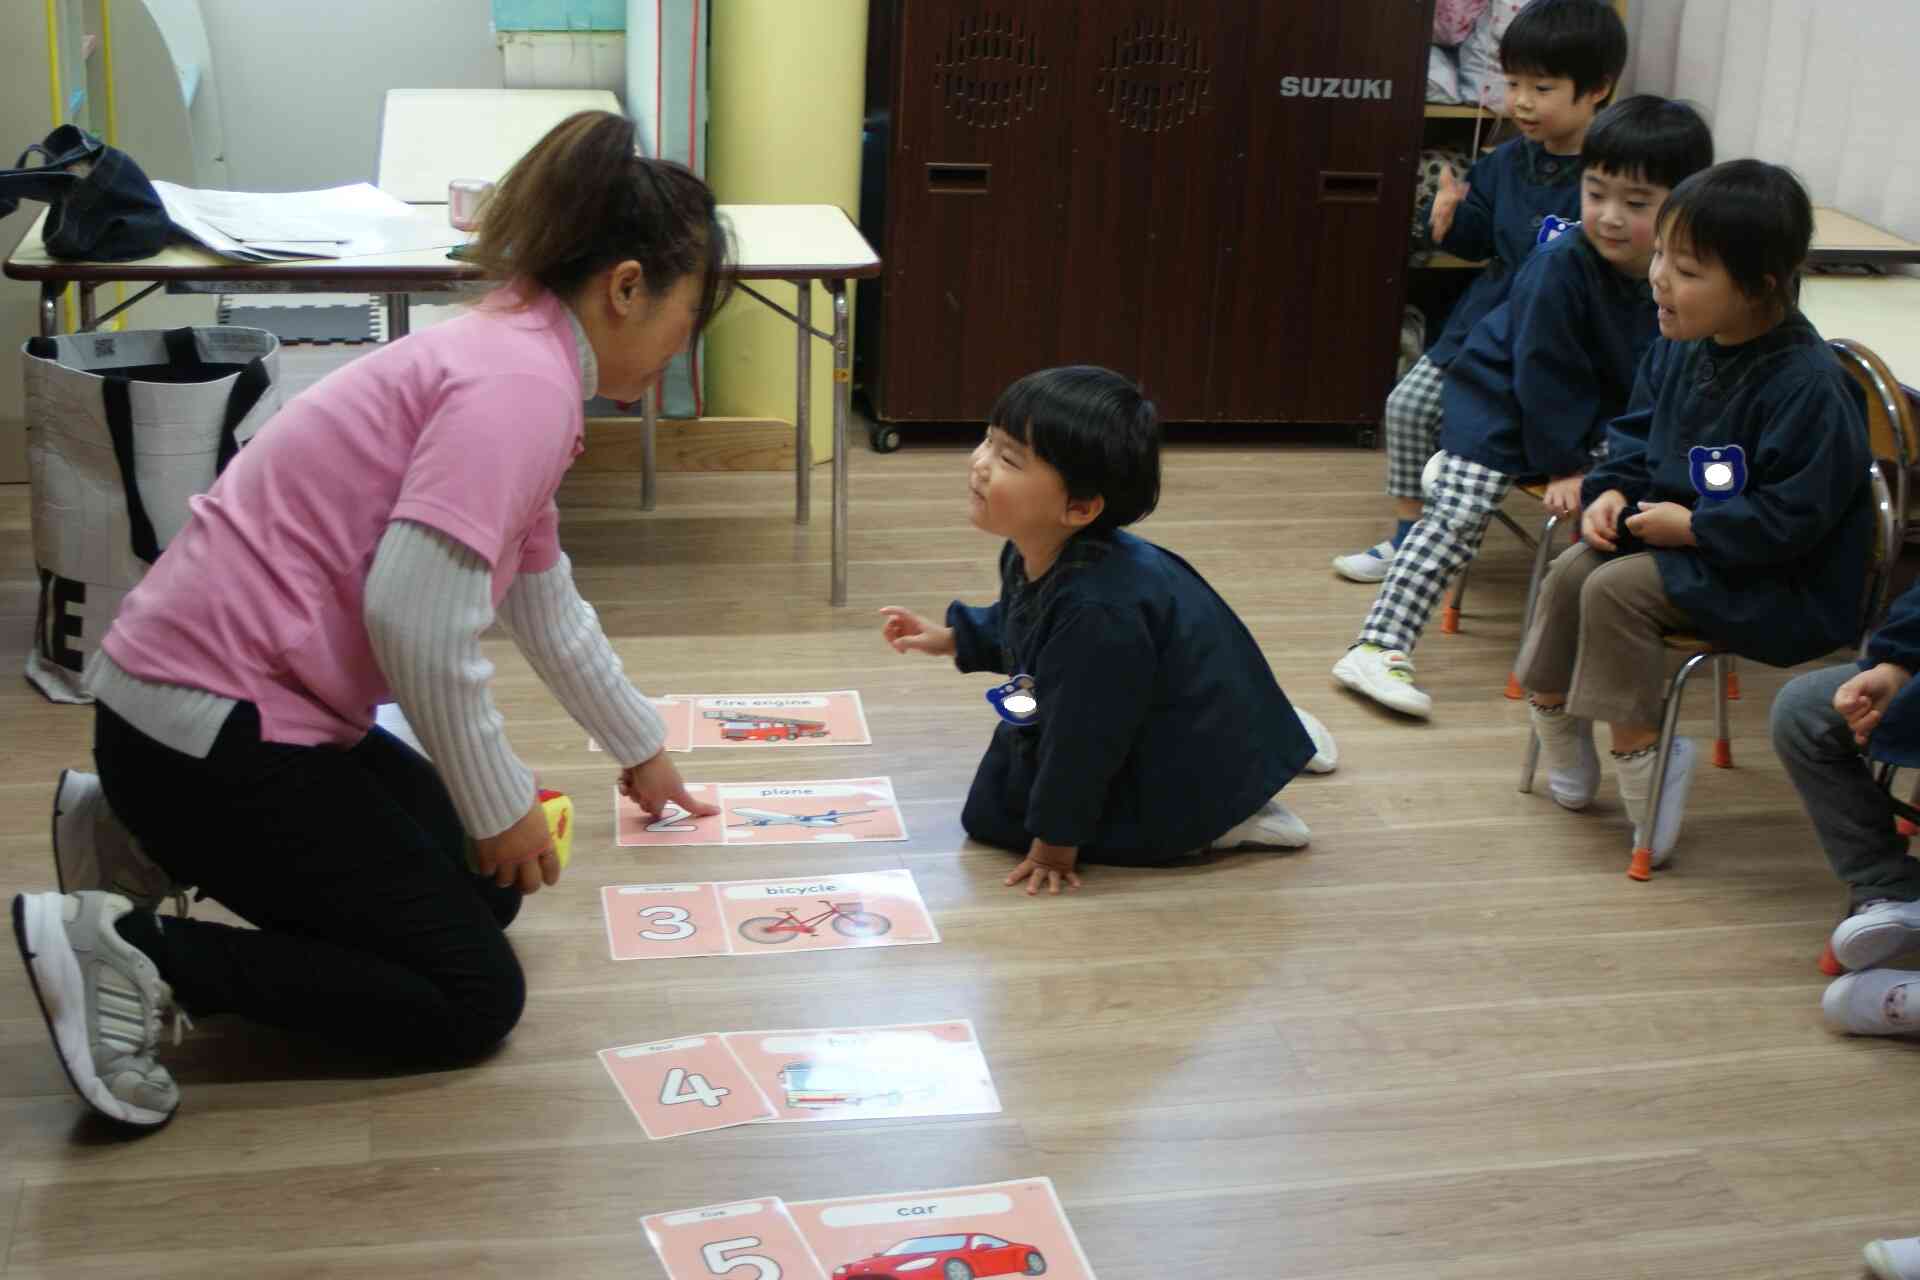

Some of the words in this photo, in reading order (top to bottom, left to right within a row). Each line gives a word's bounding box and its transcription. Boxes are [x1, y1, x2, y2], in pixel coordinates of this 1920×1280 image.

[1280, 76, 1392, 99] SUZUKI
[760, 788, 814, 797] plane
[645, 800, 698, 833] 2
[766, 884, 837, 896] bicycle
[638, 905, 697, 941] 3
[659, 1067, 731, 1108] 4
[897, 1204, 938, 1217] car
[700, 1235, 784, 1280] 5
